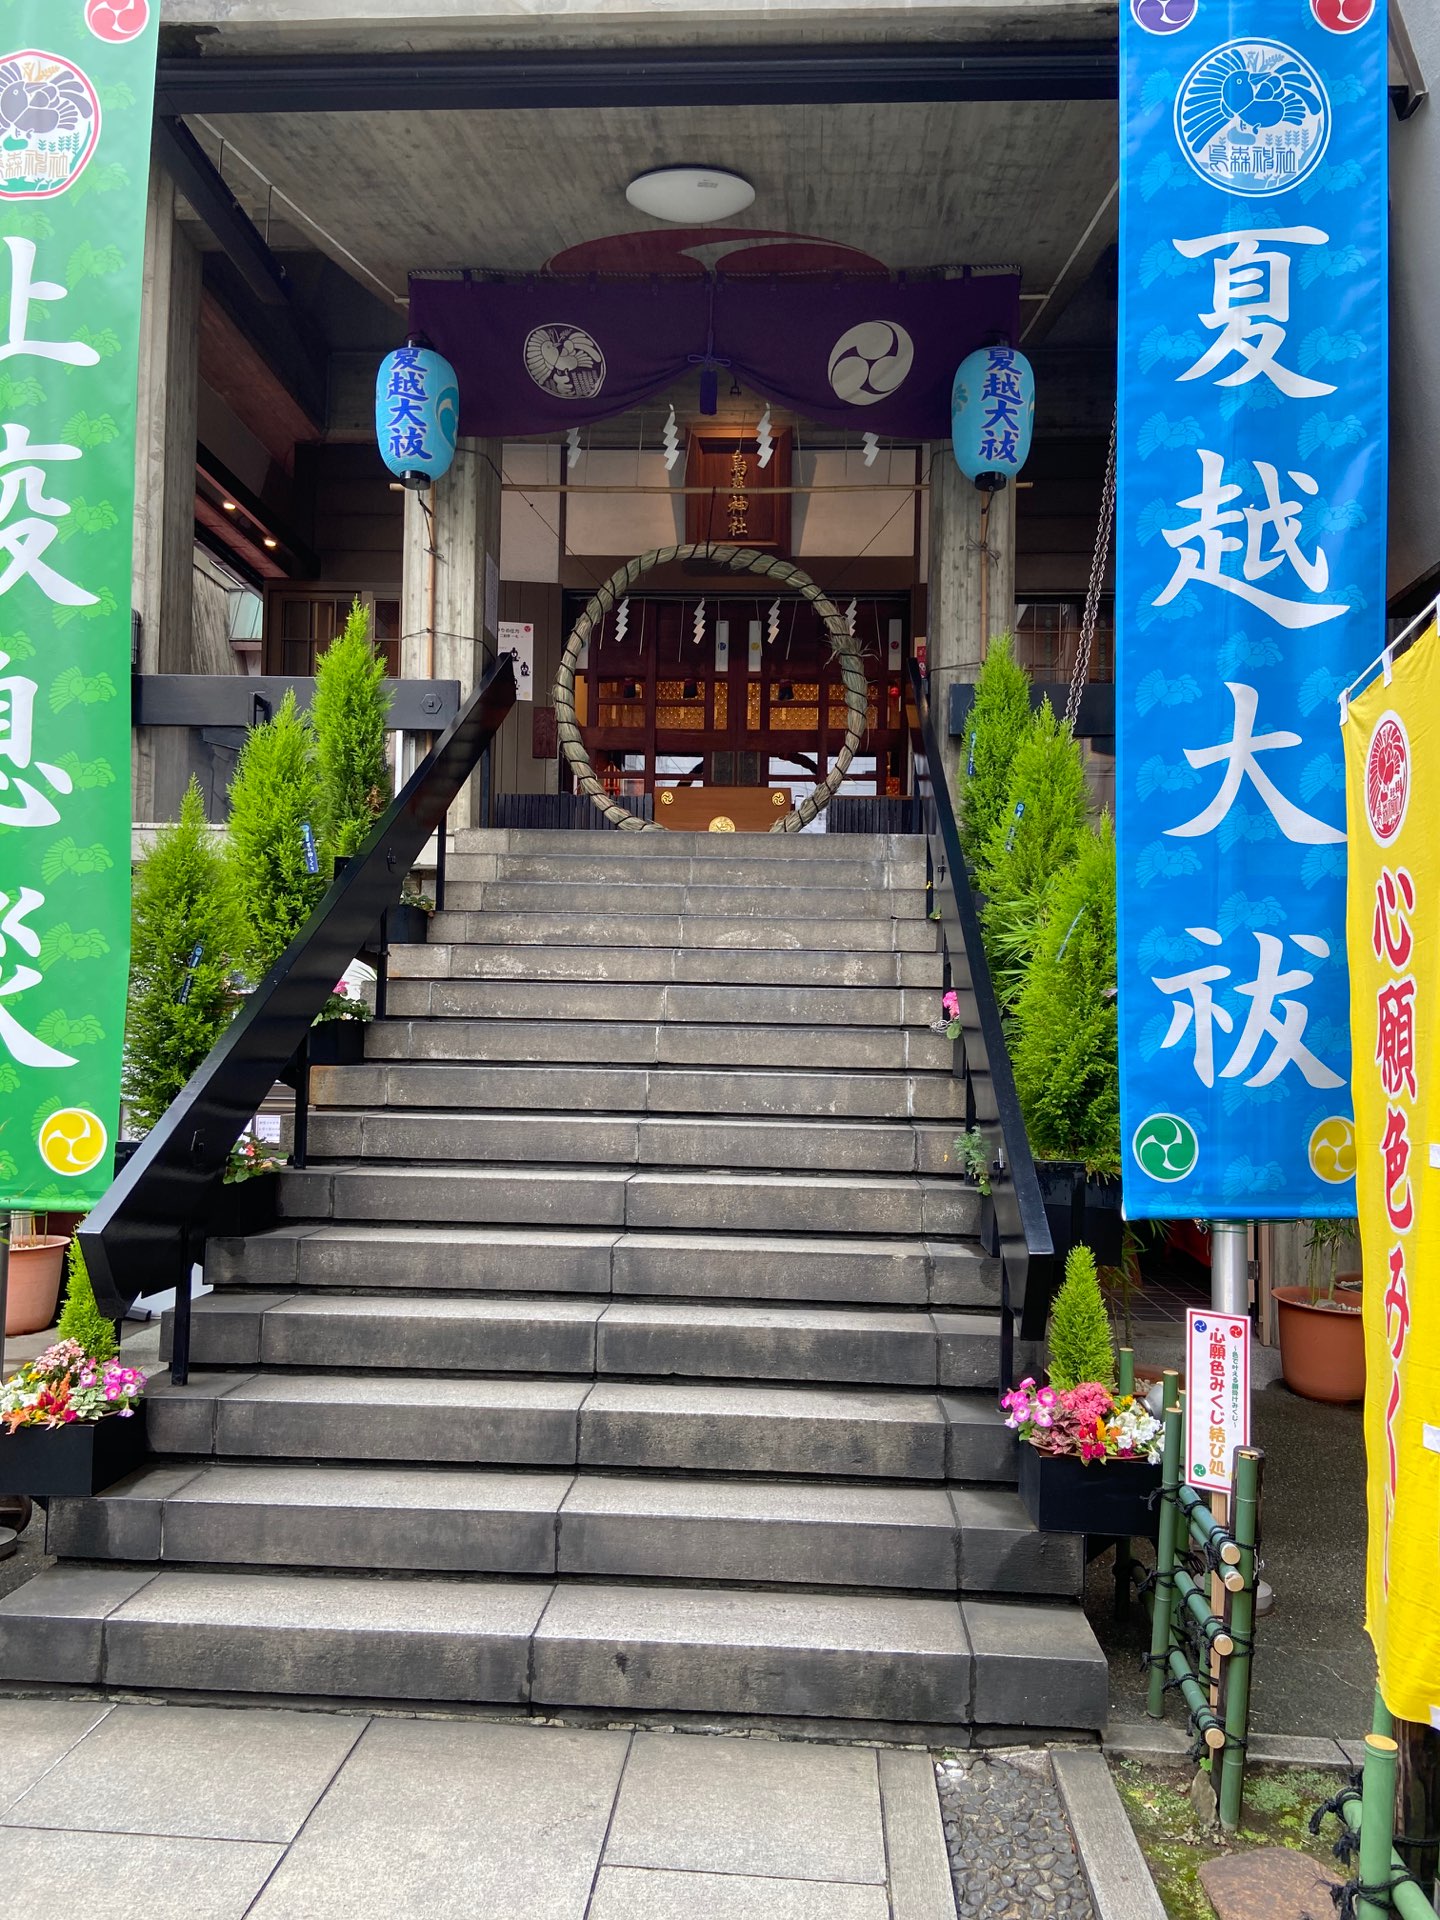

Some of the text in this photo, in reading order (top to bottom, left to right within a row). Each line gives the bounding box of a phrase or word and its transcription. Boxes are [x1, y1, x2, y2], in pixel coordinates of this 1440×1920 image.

[387, 348, 433, 460] 夏越大祓
[979, 347, 1024, 464] 夏越大祓
[1151, 226, 1350, 1089] 夏越大祓
[1374, 868, 1416, 1600] 心願色みく
[1209, 1328, 1226, 1478] 心願色みくじ結び処
